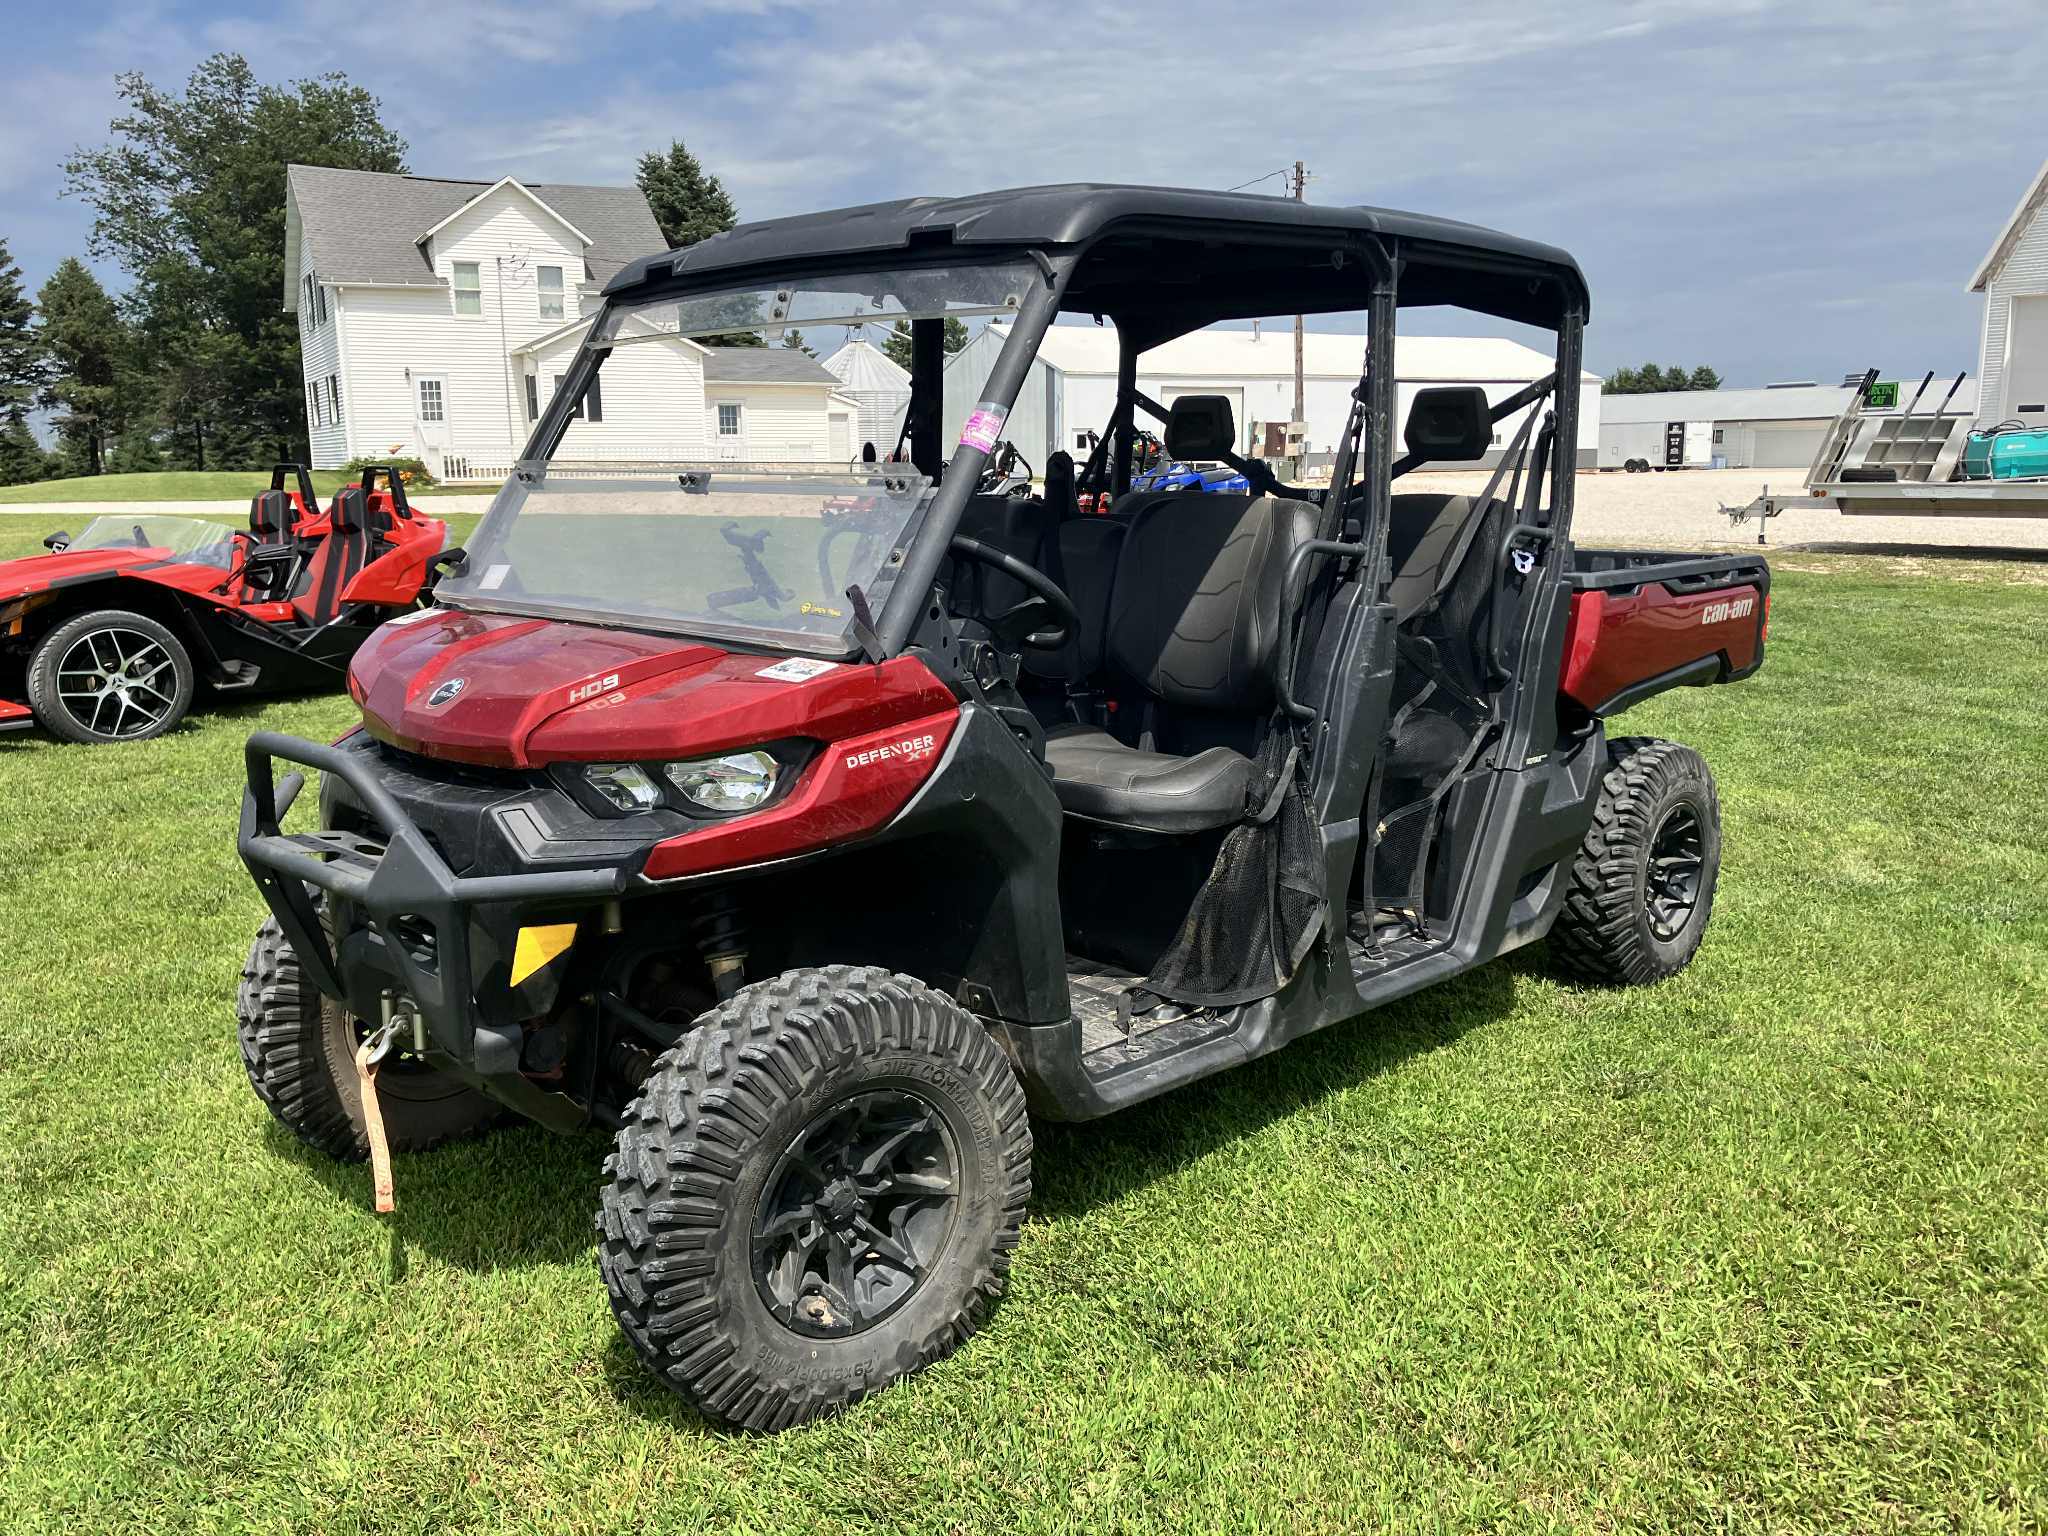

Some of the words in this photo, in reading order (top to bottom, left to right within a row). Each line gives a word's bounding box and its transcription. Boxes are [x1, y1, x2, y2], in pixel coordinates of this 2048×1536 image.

[1868, 385, 1894, 395] RCTIC
[1702, 598, 1753, 625] can-am
[569, 674, 619, 705] HD9
[846, 735, 934, 769] DEFENDER
[906, 746, 935, 762] XT
[920, 1063, 994, 1150] COMMANDER
